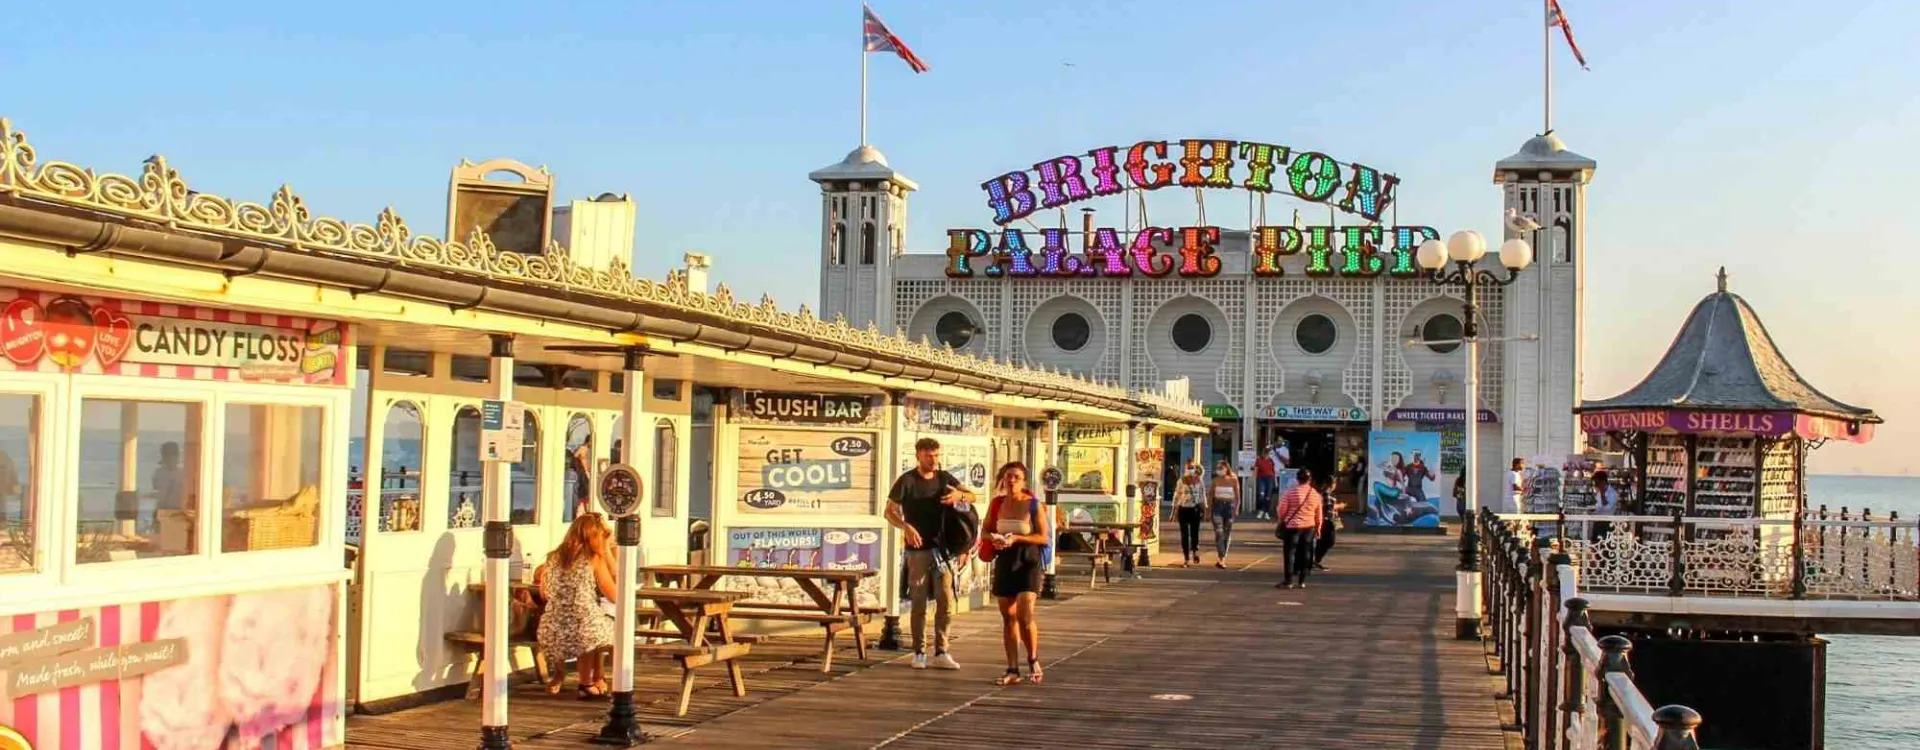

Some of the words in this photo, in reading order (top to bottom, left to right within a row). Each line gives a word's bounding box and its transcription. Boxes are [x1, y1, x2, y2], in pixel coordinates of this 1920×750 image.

[981, 138, 1401, 226] BRIGHTON
[946, 226, 1222, 278] PALACE
[1255, 225, 1440, 278] PIER
[99, 332, 121, 346] LOVE
[136, 323, 227, 357] CANDY
[233, 331, 300, 362] FLOSS
[754, 397, 818, 417] SLUSH
[824, 401, 862, 418] BAR
[1293, 407, 1312, 415] THIS
[1313, 407, 1334, 415] WAY
[1397, 411, 1418, 420] WHERE
[1420, 411, 1445, 421] TICKETS
[932, 408, 950, 425] SLUSH
[1582, 411, 1665, 430] SOUVENIRS
[1687, 411, 1773, 432] SHELLS
[835, 439, 862, 452] £2.50
[766, 448, 803, 465] GET
[1135, 448, 1164, 462] LOVE
[768, 462, 848, 489] COOL!
[747, 490, 775, 503] £4.50
[733, 532, 751, 540] OUT
[753, 531, 763, 539] OF
[767, 530, 785, 538] THIS
[788, 529, 818, 537] WORLD
[755, 537, 816, 548] FLAVOURS!
[23, 630, 49, 652] and
[52, 622, 91, 645] sweet!
[16, 666, 49, 687] Made
[90, 652, 118, 672] while
[119, 654, 141, 672] you
[144, 644, 175, 662] wait!
